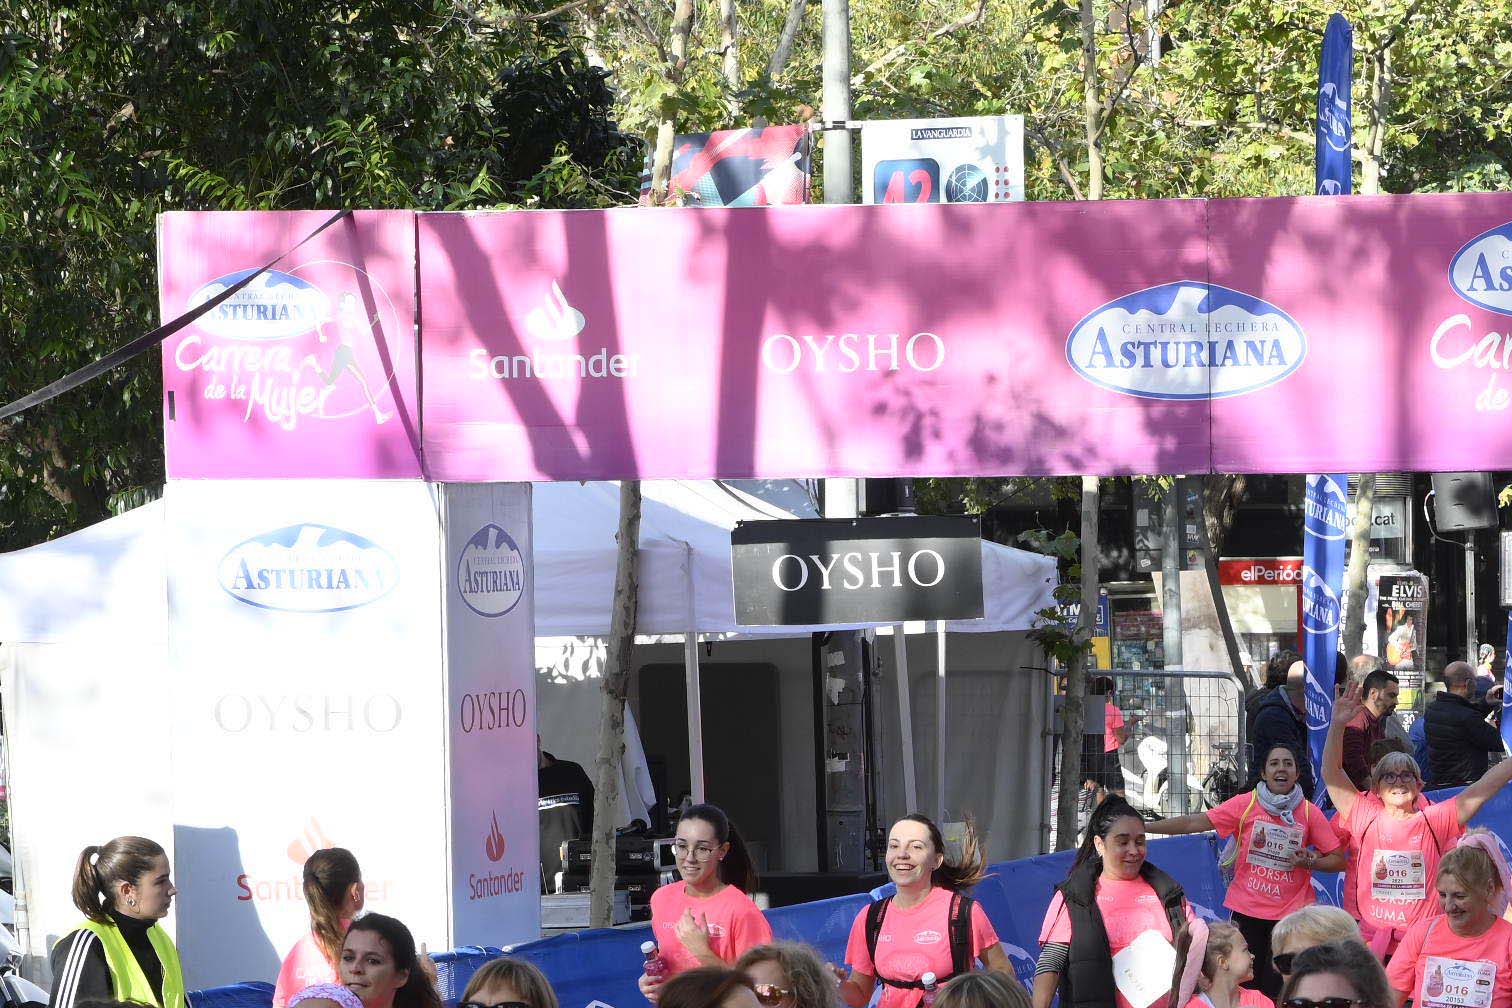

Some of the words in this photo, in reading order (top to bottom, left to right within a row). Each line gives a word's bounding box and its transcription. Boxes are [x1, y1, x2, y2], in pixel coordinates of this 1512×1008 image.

[923, 127, 972, 139] VANGUARDIA
[1121, 322, 1197, 336] CENTRAL
[1204, 322, 1281, 335] LECHERA
[175, 335, 294, 372] Carrera
[761, 331, 946, 375] OYSHO
[1085, 325, 1287, 370] ASTURIANA
[469, 346, 641, 381] Santander
[204, 374, 226, 400] de
[230, 375, 246, 400] la
[244, 370, 337, 431] Mujer
[1475, 372, 1509, 412] de
[463, 566, 521, 595] ASTURIANA
[771, 549, 946, 592] OYSHO
[1391, 584, 1423, 598] ELVIS
[213, 693, 403, 734] OYSHO
[460, 687, 527, 734] OYSHO
[1266, 839, 1284, 850] 016
[469, 869, 525, 901] Santander
[1247, 877, 1281, 896] SUMA
[1250, 866, 1294, 883] DORSAL
[1387, 868, 1407, 877] 016
[1445, 984, 1469, 996] 016
